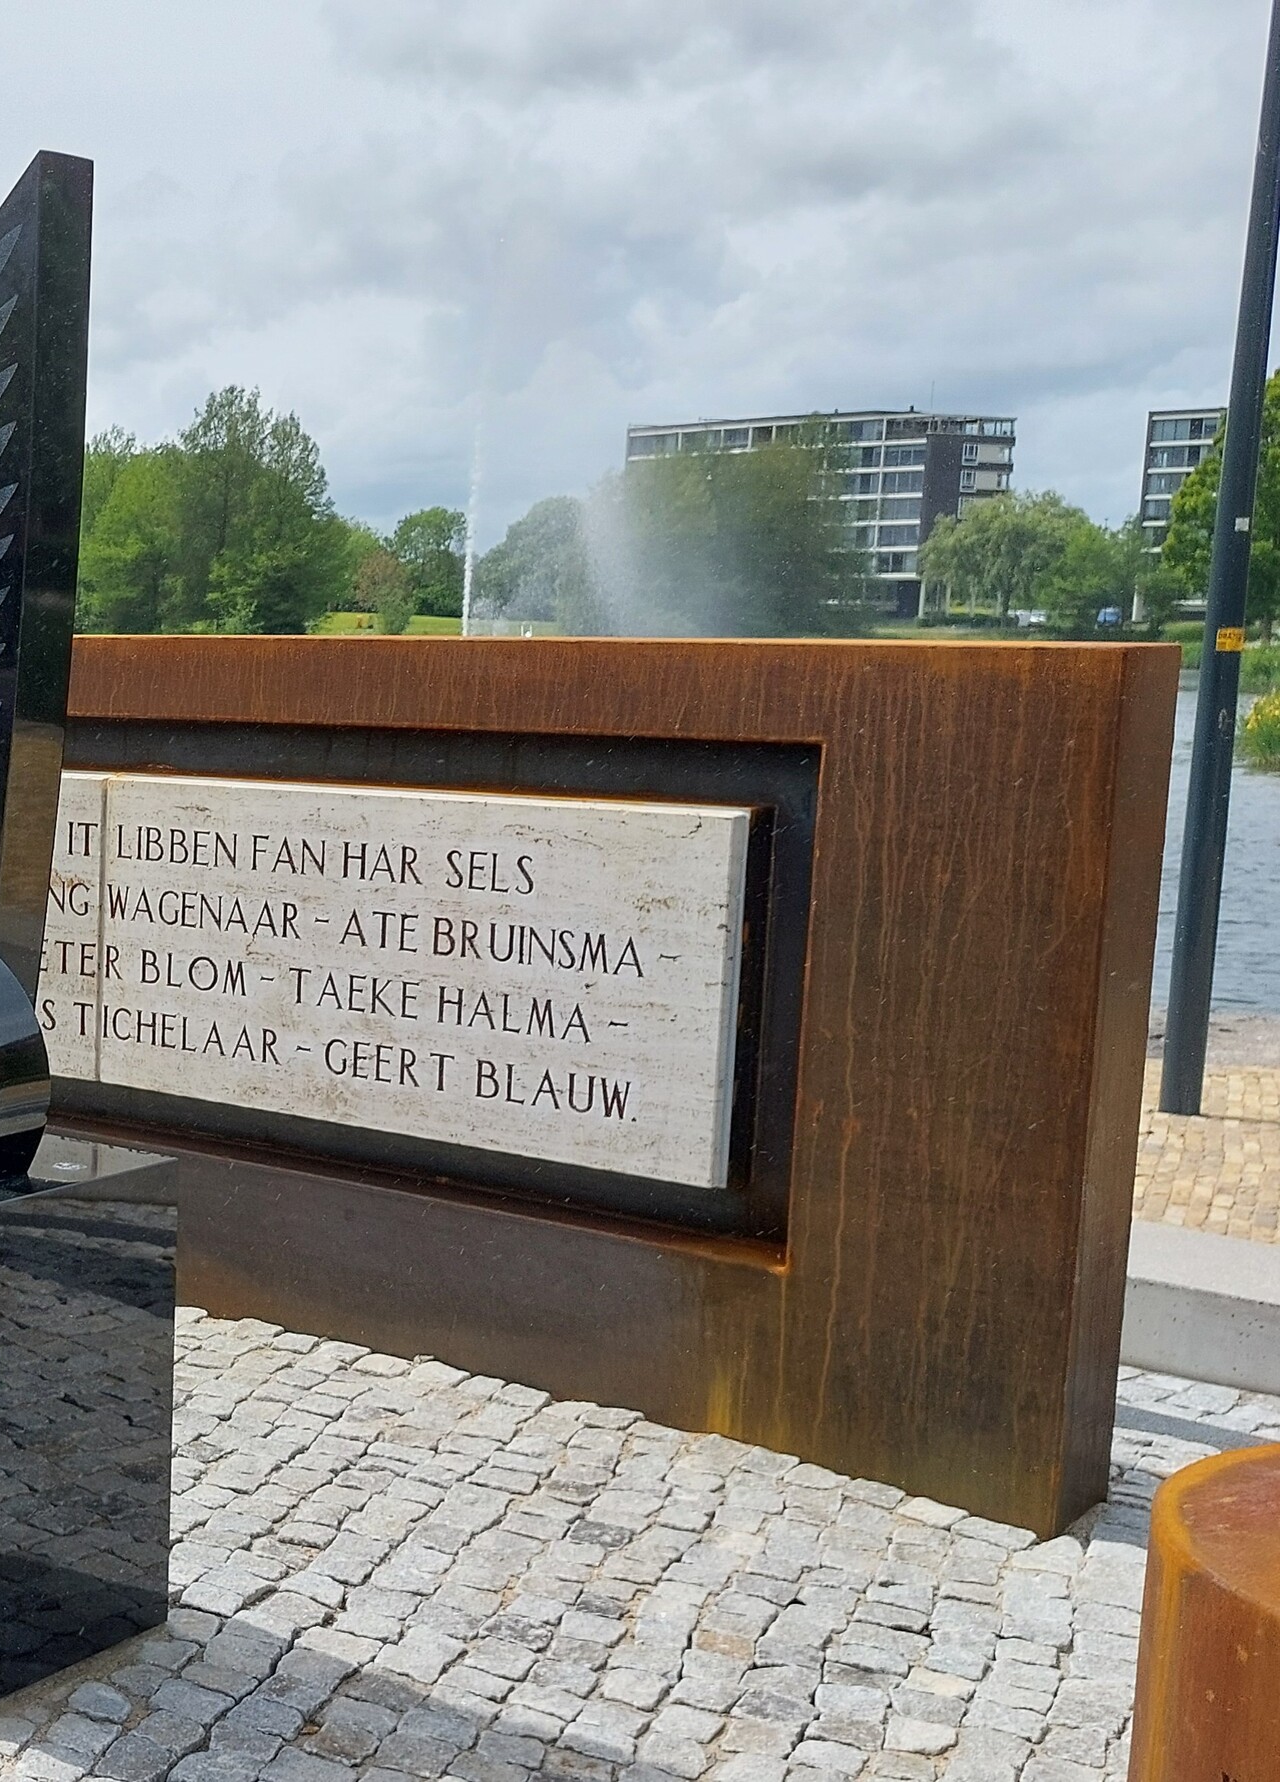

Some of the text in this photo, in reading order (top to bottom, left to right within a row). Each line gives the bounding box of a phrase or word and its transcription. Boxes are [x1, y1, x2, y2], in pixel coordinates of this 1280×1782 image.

[67, 821, 98, 856] IT
[117, 824, 238, 869] LIBBEN
[251, 835, 326, 876] FAN
[342, 841, 422, 885] HAR
[445, 850, 534, 895] SELS
[107, 884, 301, 939] WAGENAAR
[340, 908, 419, 953] ATE
[433, 917, 644, 978] BRUINSMA
[141, 949, 247, 996] BLOM
[289, 967, 420, 1021] TAEKE
[437, 985, 591, 1044] HALMA
[73, 1001, 281, 1065] TICHELAAR
[325, 1038, 455, 1092] GEERT
[475, 1058, 637, 1122] BLAUW.
